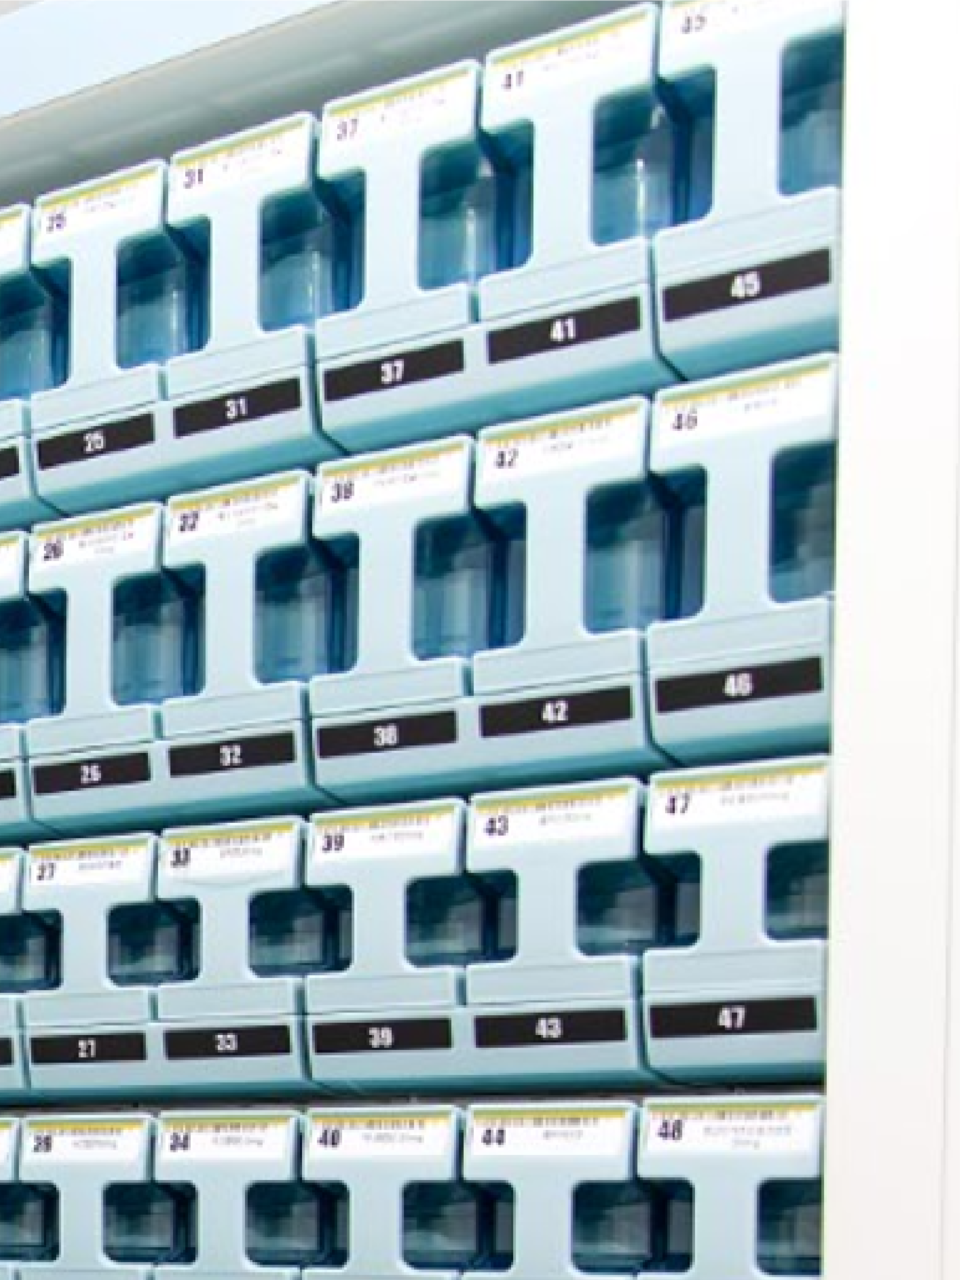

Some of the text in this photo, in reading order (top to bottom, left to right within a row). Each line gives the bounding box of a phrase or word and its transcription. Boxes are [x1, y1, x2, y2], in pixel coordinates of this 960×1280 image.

[337, 119, 358, 141] 37
[731, 272, 760, 298] 45
[551, 319, 576, 342] 41
[381, 359, 405, 384] 37
[225, 397, 247, 418] 31
[495, 450, 518, 469] 42
[724, 673, 753, 697] 46
[542, 701, 569, 724] 42
[219, 744, 243, 766] 32
[665, 795, 690, 814] 47
[483, 815, 509, 836] 43
[322, 834, 344, 853] 39
[36, 862, 55, 880] 27
[535, 1017, 562, 1039] 43
[718, 1006, 745, 1029] 47
[214, 1034, 238, 1052] 33
[368, 1027, 393, 1048] 39
[78, 1039, 97, 1058] 27
[317, 1131, 341, 1148] 40
[482, 1128, 506, 1146] 44
[657, 1120, 683, 1140] 48
